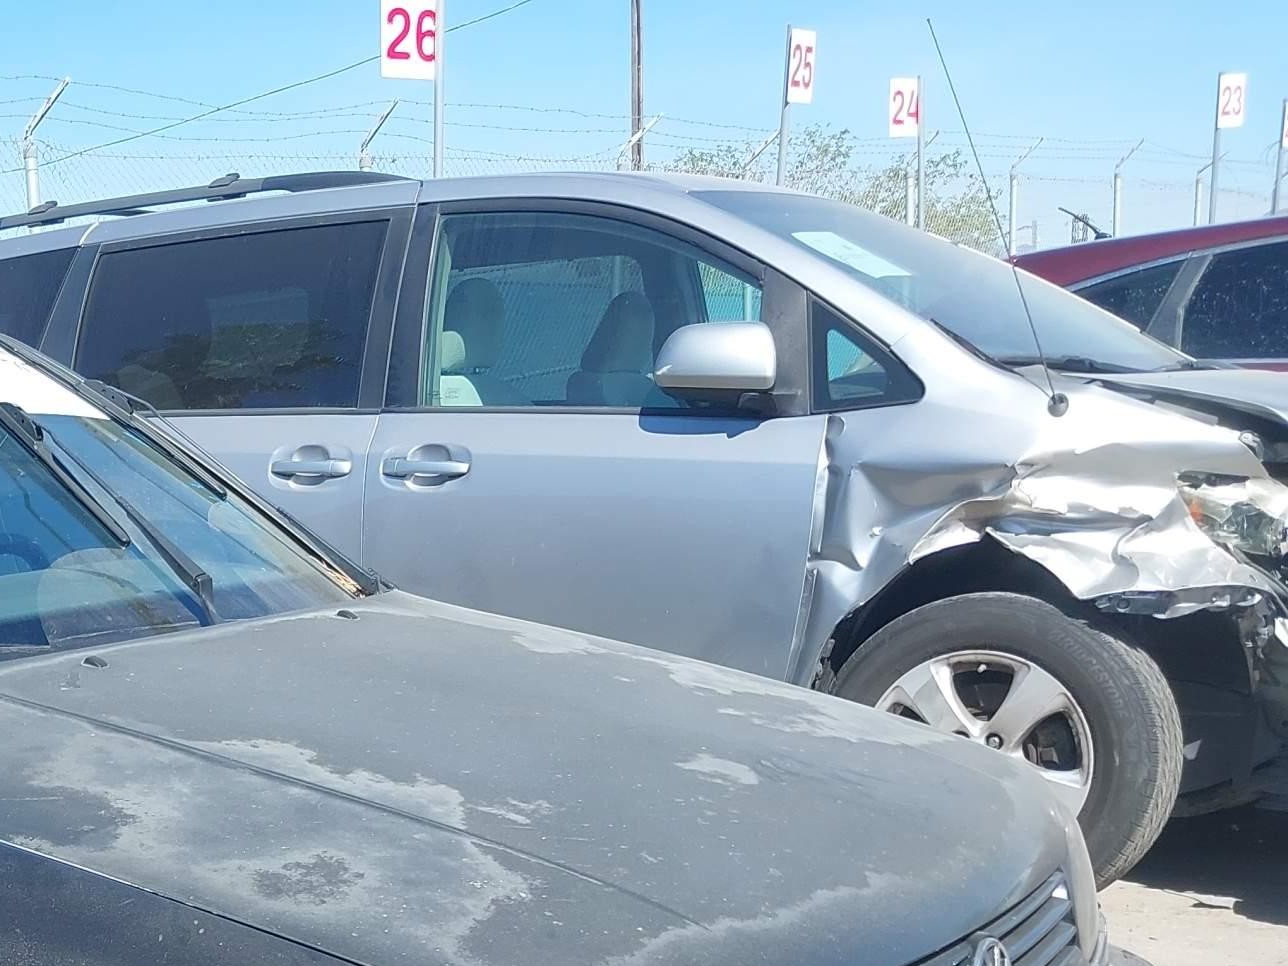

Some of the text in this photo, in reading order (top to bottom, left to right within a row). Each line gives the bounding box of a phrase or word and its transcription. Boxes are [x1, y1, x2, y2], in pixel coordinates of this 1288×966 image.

[387, 7, 435, 62] 26
[791, 43, 813, 89] 25
[892, 90, 918, 125] 24
[1221, 85, 1242, 116] 23
